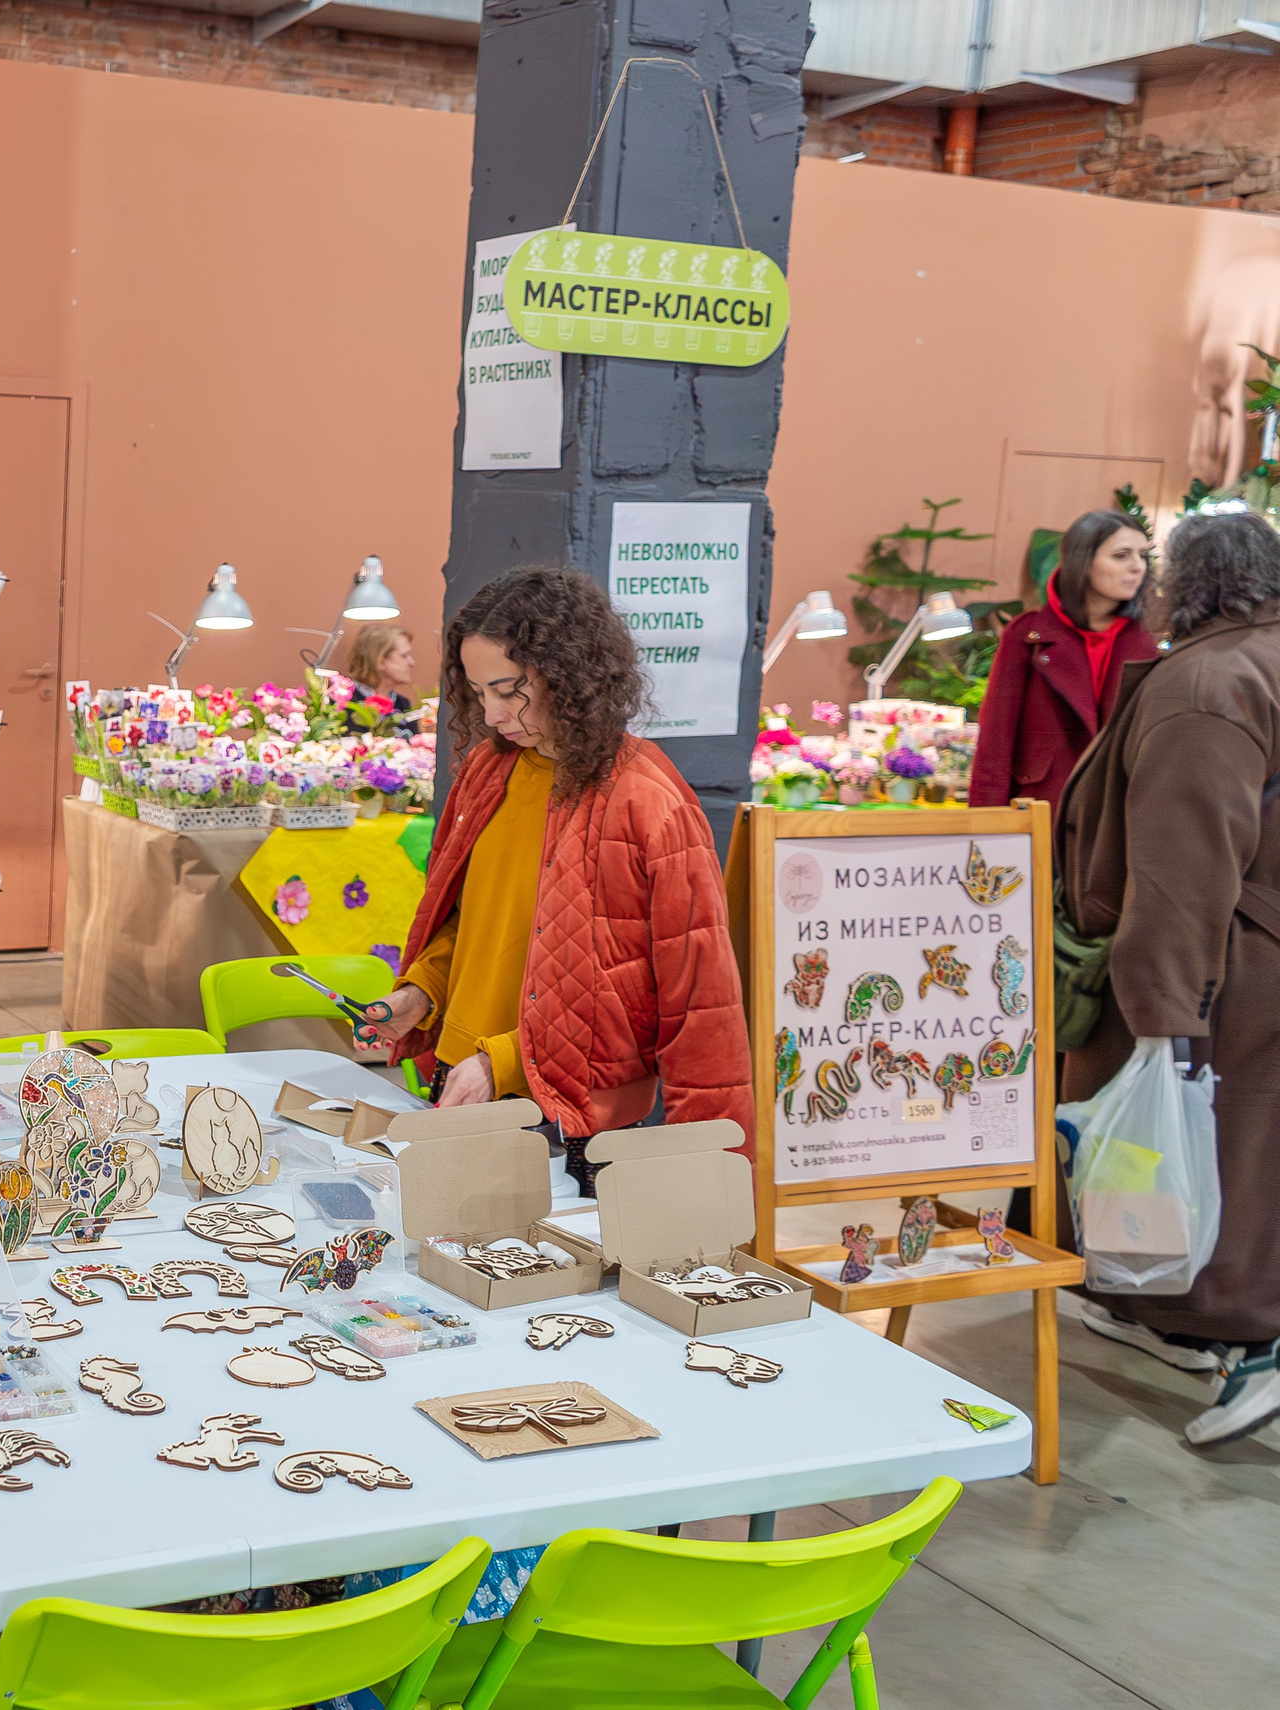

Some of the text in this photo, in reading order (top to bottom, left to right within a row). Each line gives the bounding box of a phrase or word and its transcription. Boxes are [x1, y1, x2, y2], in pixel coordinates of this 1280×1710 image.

[480, 254, 512, 278] МОР
[523, 279, 772, 328] МАСТЕР-КЛАССЫ
[469, 359, 552, 385] В РАСТЕНИЯХ
[617, 543, 740, 561] НЕВОЗМОЖНО
[616, 577, 710, 595] ПЕРЕСТАТЬ
[634, 646, 700, 663] СТЕНИЯ
[835, 865, 961, 889] МОЗАИКА
[798, 914, 1004, 942] ИЗ МИНЕРАЛОВ
[798, 1016, 1006, 1048] МАСТЕР-КЛАСС
[908, 1104, 935, 1117] 1500
